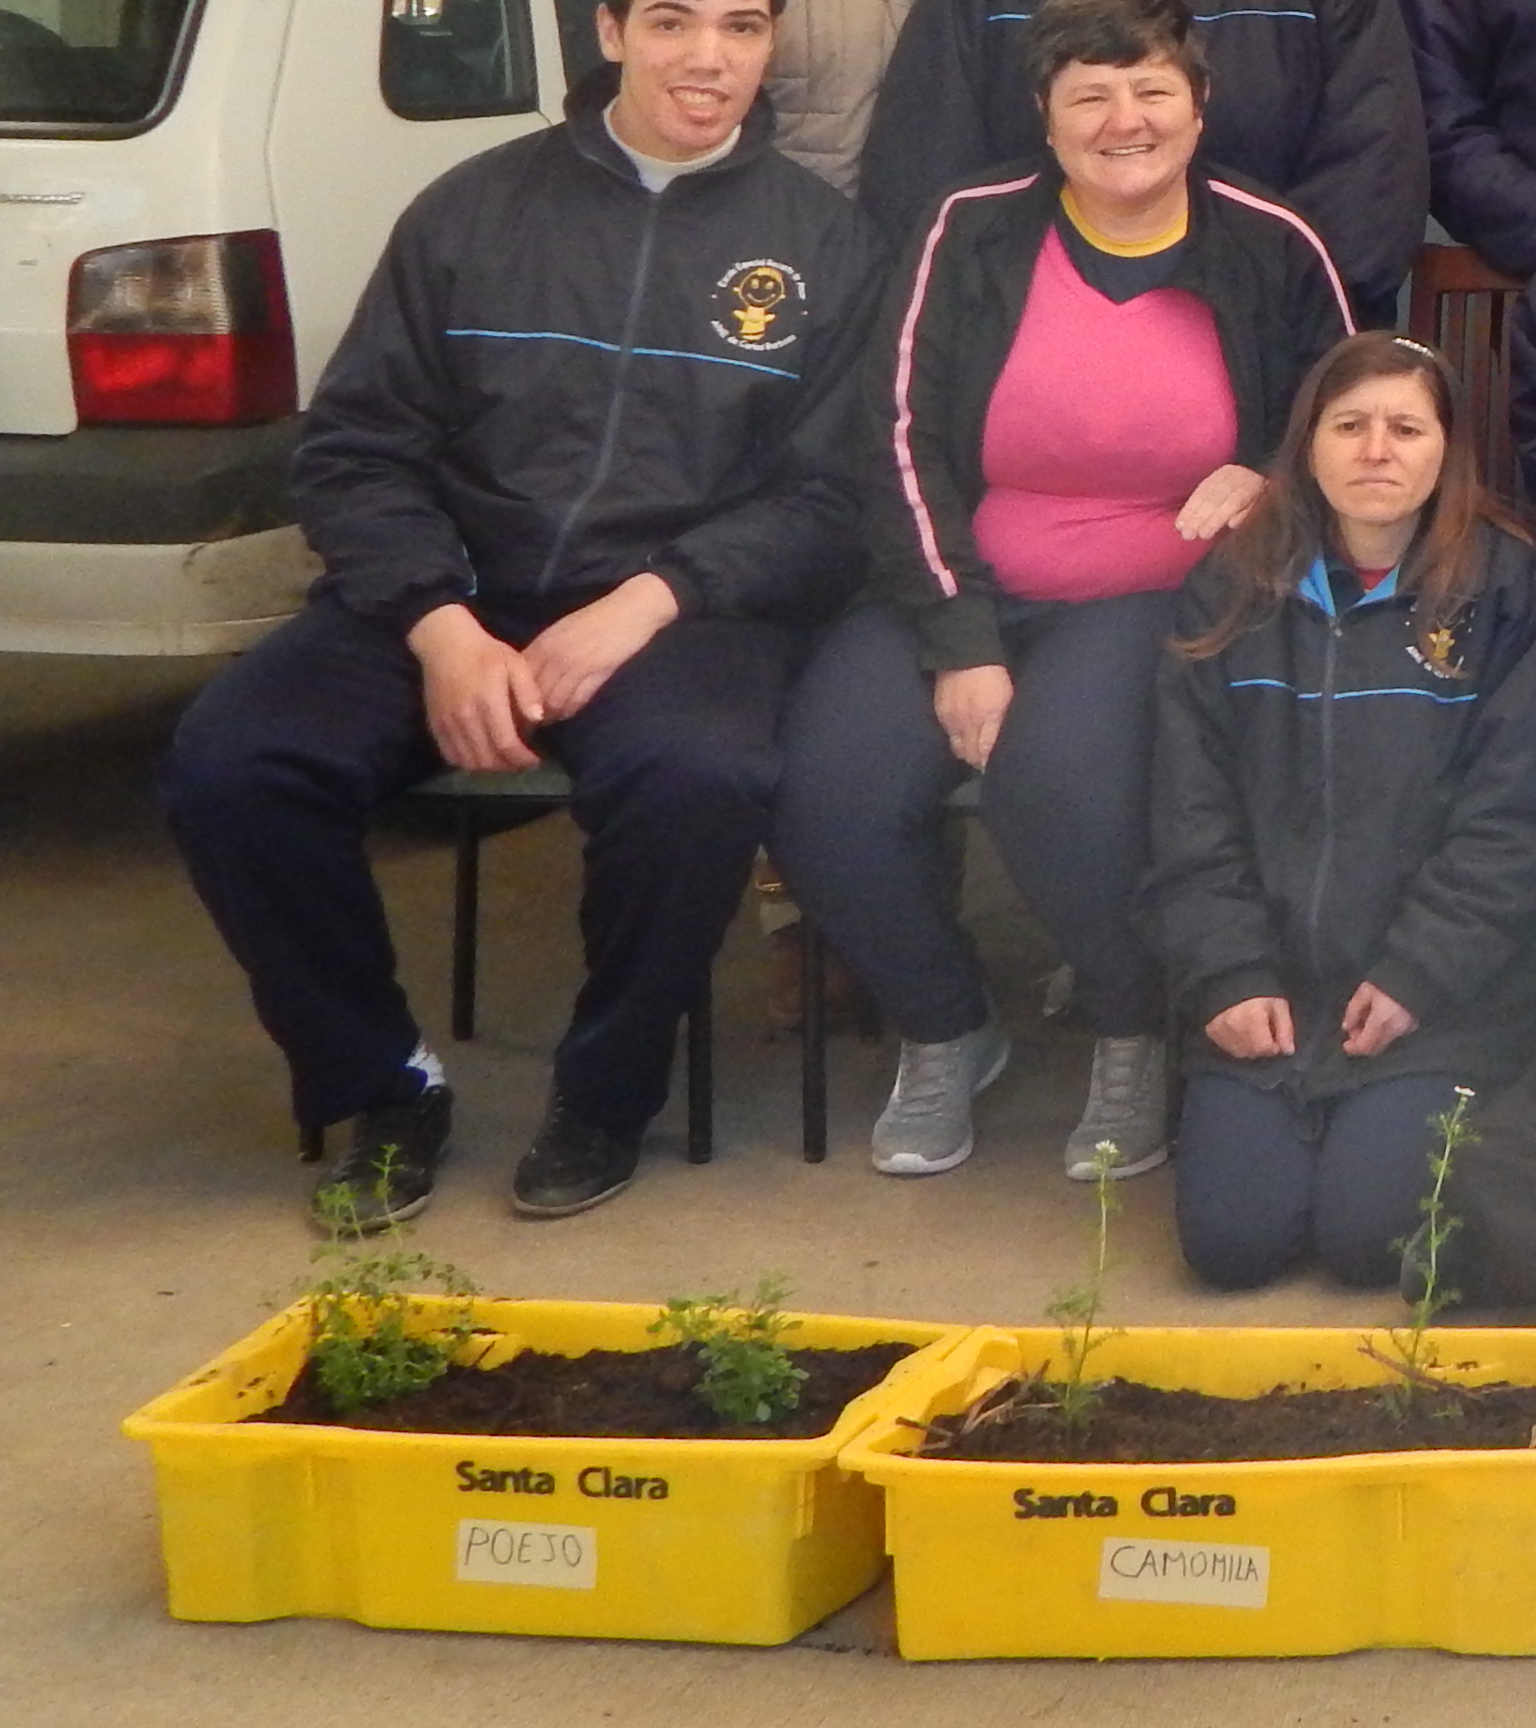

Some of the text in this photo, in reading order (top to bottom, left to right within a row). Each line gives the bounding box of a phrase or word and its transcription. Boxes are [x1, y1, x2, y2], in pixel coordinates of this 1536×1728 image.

[455, 1460, 670, 1500] Santa Clara
[1013, 1486, 1236, 1519] Santa Clara
[464, 1526, 583, 1568] POEJO
[1110, 1545, 1259, 1583] CAMOMILA
